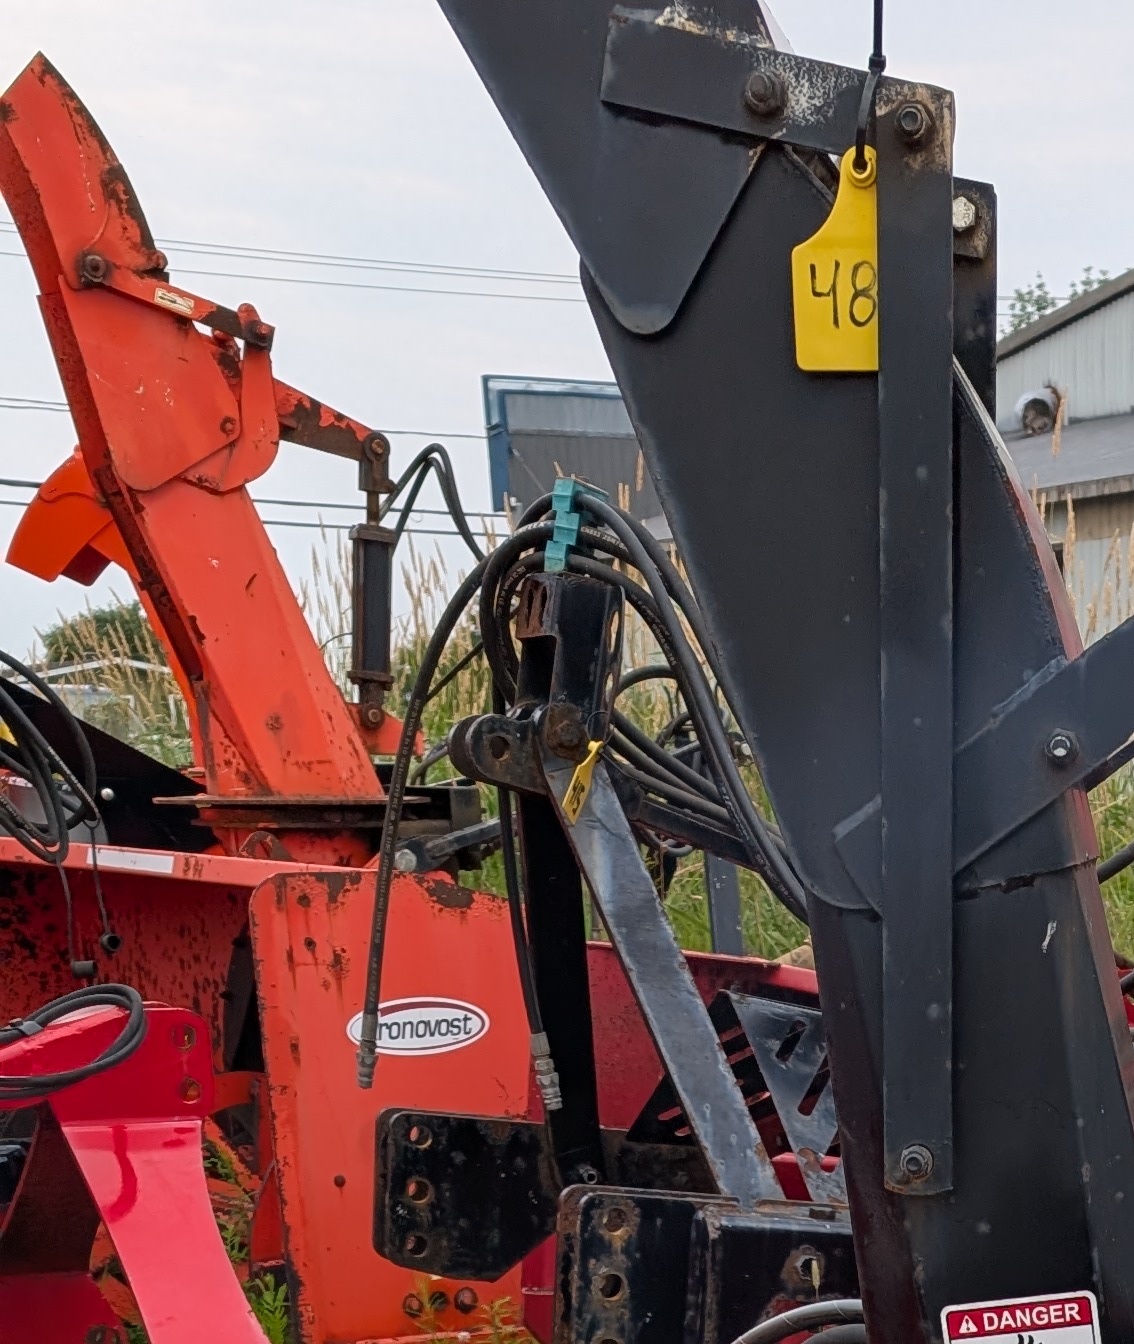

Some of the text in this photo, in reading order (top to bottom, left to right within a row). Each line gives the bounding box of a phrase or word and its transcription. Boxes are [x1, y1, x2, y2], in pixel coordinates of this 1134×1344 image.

[809, 259, 877, 329] 48
[374, 1013, 473, 1041] ronovost
[982, 1302, 1082, 1332] DANGER
